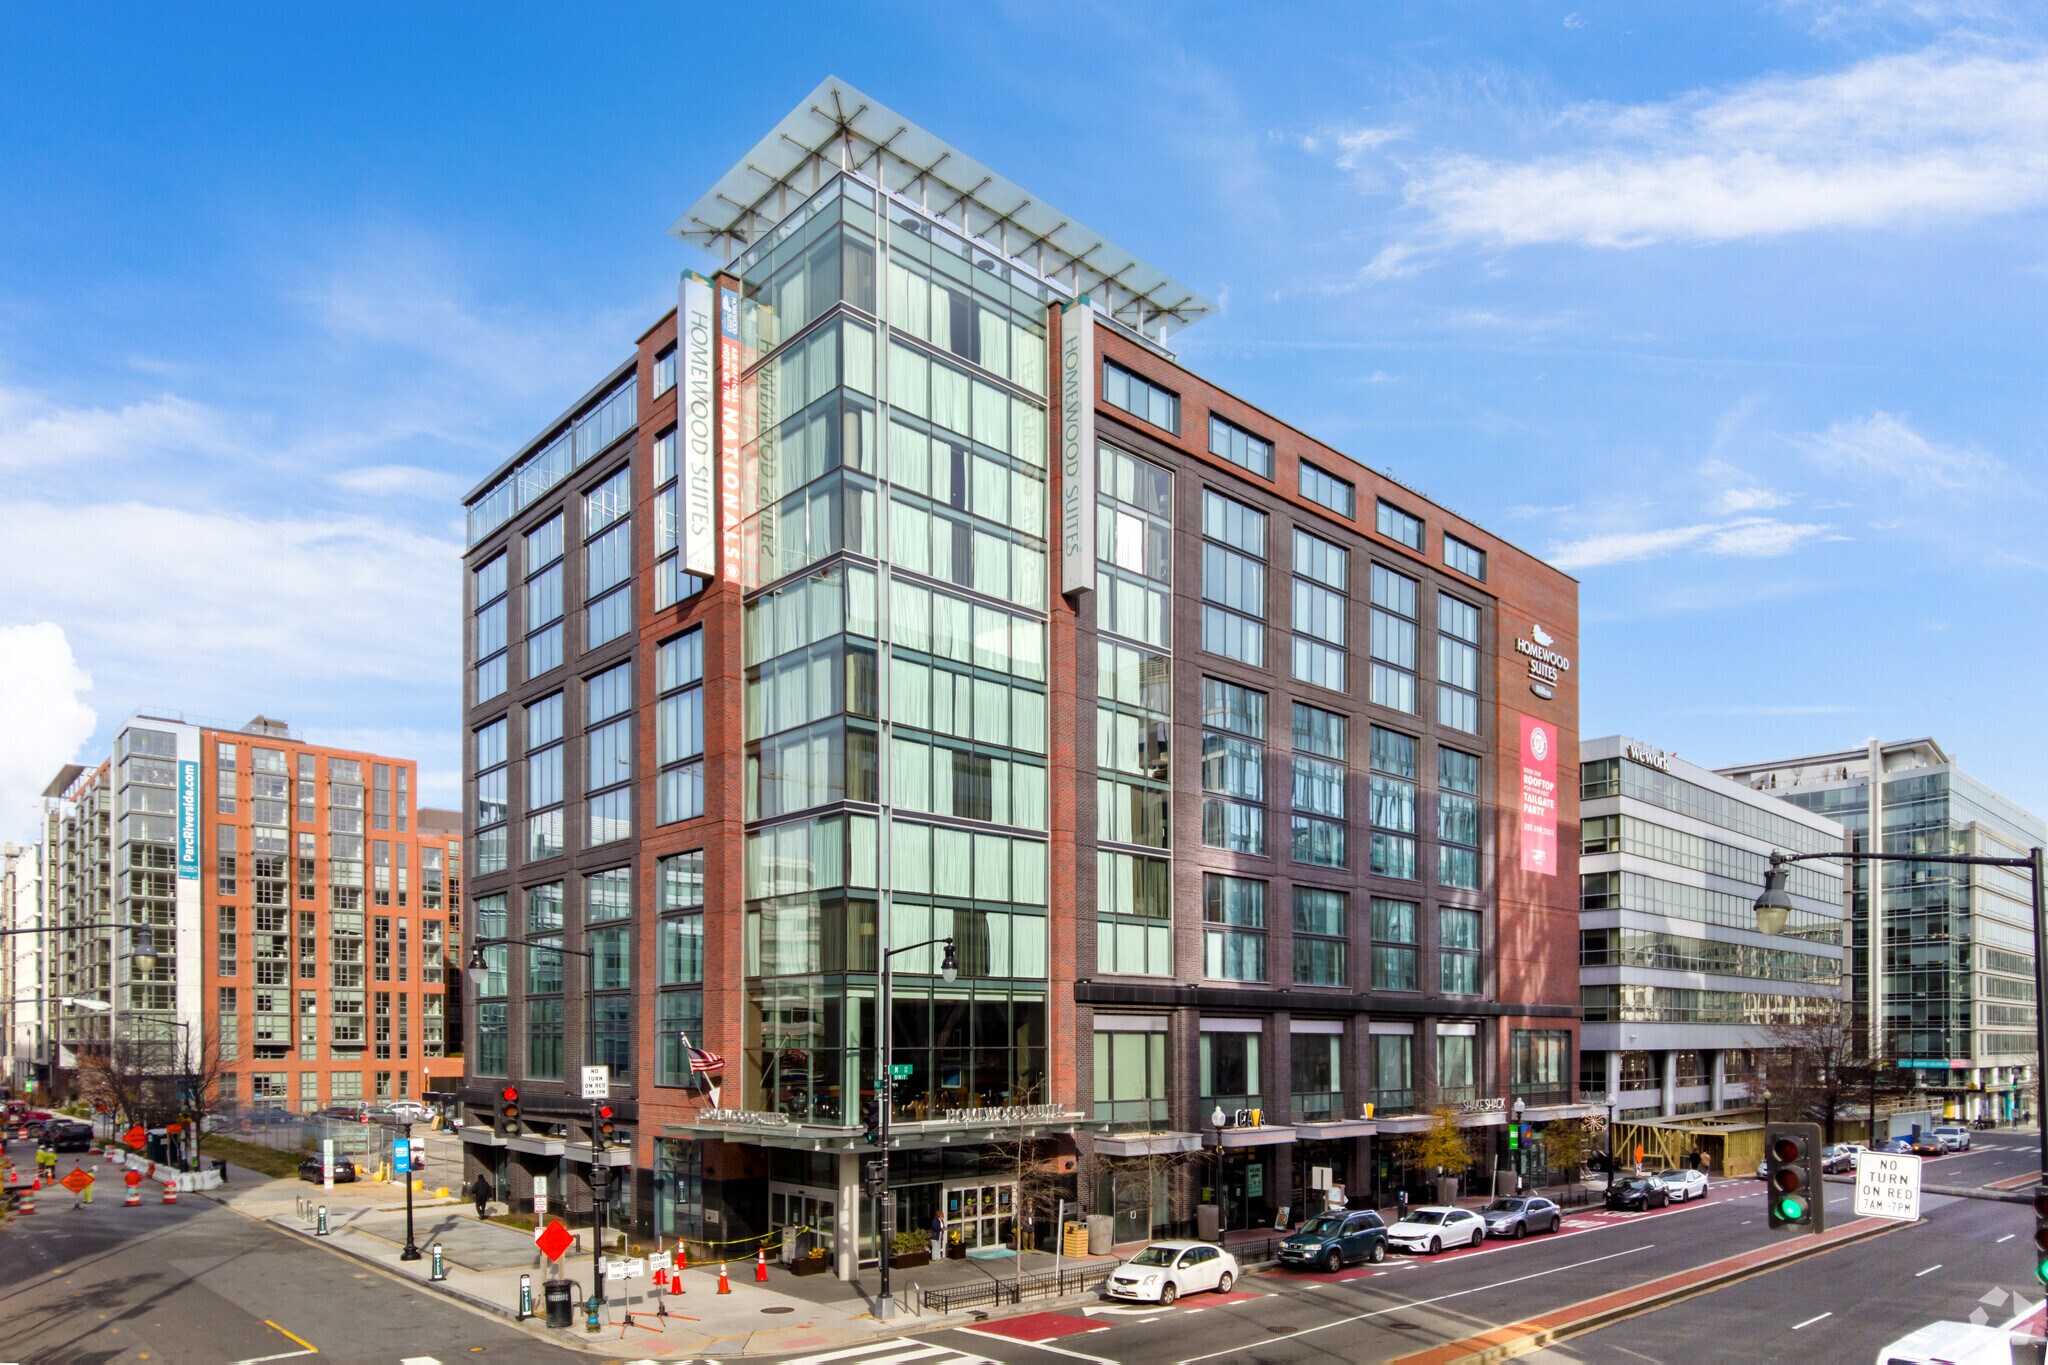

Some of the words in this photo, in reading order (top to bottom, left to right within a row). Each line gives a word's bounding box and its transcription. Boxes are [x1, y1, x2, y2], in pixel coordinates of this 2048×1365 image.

[691, 310, 708, 455] HOMEWOOD
[723, 371, 730, 384] OF
[1065, 335, 1078, 477] HOMEWOOD
[722, 406, 740, 560] NATIONALS
[691, 463, 709, 536] SUITES
[1065, 484, 1078, 557] SUITES
[1516, 637, 1570, 671] HOMEWOOD
[1530, 660, 1558, 681] SUITES
[1629, 745, 1670, 771] wework
[1523, 774, 1554, 791] ROOFTOP
[1524, 792, 1555, 809] TAILGATE
[1524, 803, 1545, 816] PARTY
[183, 764, 195, 862] ParcRiverside.com
[946, 1106, 1027, 1124] HOMEWOOD
[1027, 1103, 1066, 1118] SUITES
[1463, 1100, 1484, 1112] SHAKE
[1484, 1098, 1506, 1110] SHACK
[1880, 1160, 1898, 1170] NO
[1870, 1172, 1908, 1185] TURN
[1863, 1185, 1880, 1196] ON
[1888, 1188, 1912, 1200] RED
[650, 1252, 670, 1262] SIDEWALK
[652, 1262, 668, 1270] CLOSED
